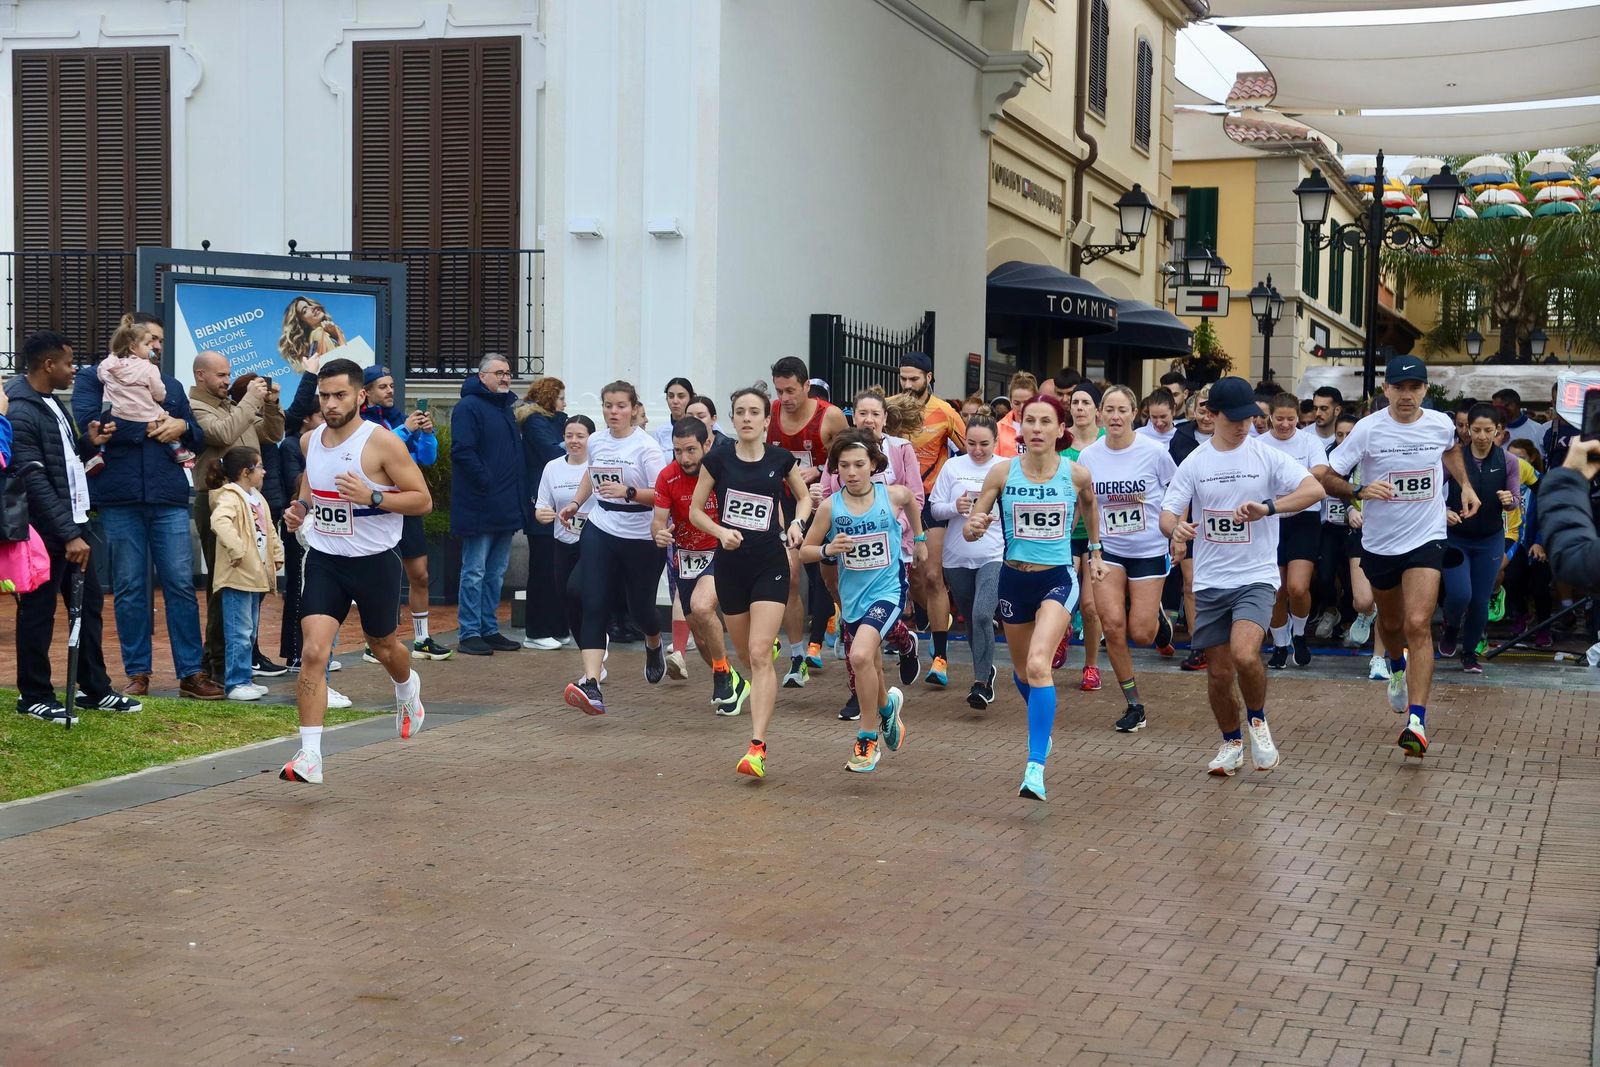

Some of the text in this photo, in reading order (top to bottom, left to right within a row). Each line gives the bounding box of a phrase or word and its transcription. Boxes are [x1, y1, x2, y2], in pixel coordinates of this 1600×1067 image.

[1047, 294, 1108, 319] TOMMY
[194, 308, 264, 339] BIENVENIDO
[199, 328, 247, 351] WELCOME
[217, 339, 254, 356] NVENUE
[1006, 485, 1058, 499] nerja
[1394, 477, 1431, 492] 188
[315, 505, 347, 523] 206
[728, 499, 767, 519] 226
[1107, 510, 1141, 524] 114
[836, 520, 877, 536] nerja
[1019, 512, 1061, 527] 163
[1207, 518, 1245, 532] 189
[846, 541, 884, 558] 283
